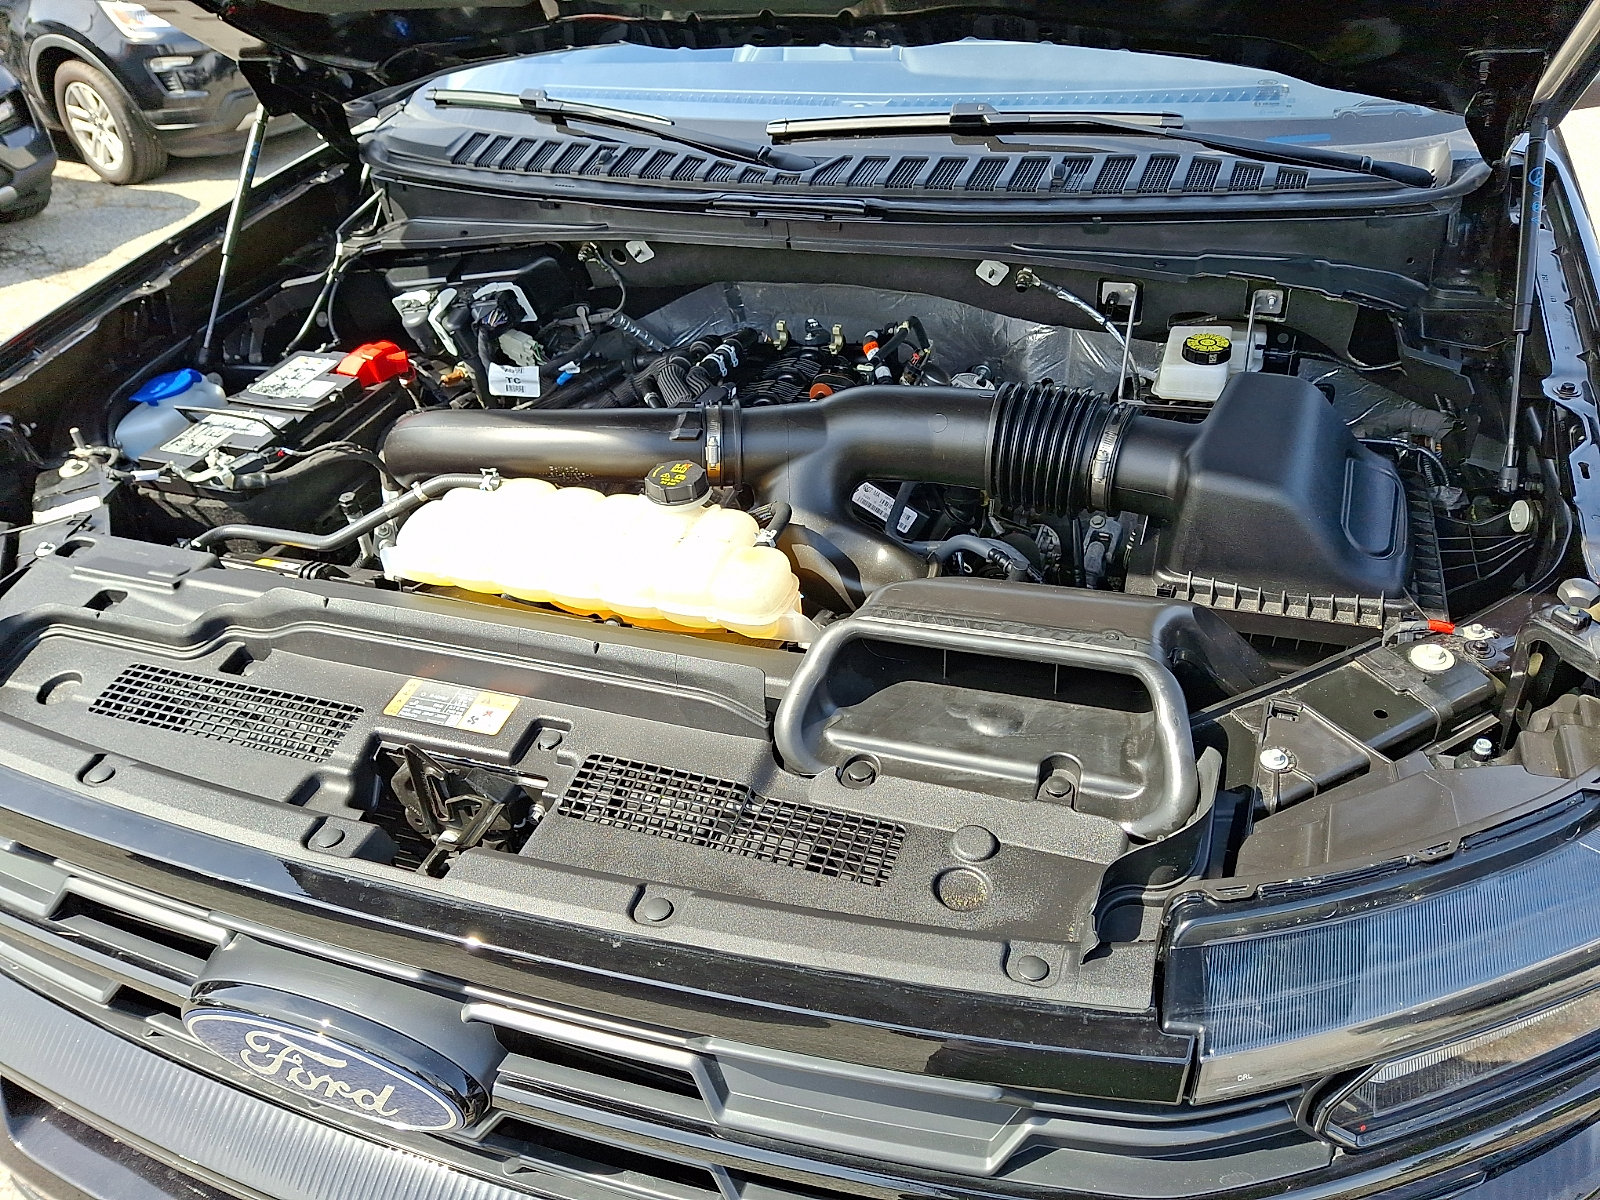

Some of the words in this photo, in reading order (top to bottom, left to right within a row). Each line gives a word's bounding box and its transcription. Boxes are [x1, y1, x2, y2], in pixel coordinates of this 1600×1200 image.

[505, 376, 522, 385] TC
[239, 1030, 399, 1117] Ford
[1237, 1072, 1254, 1082] DRL
